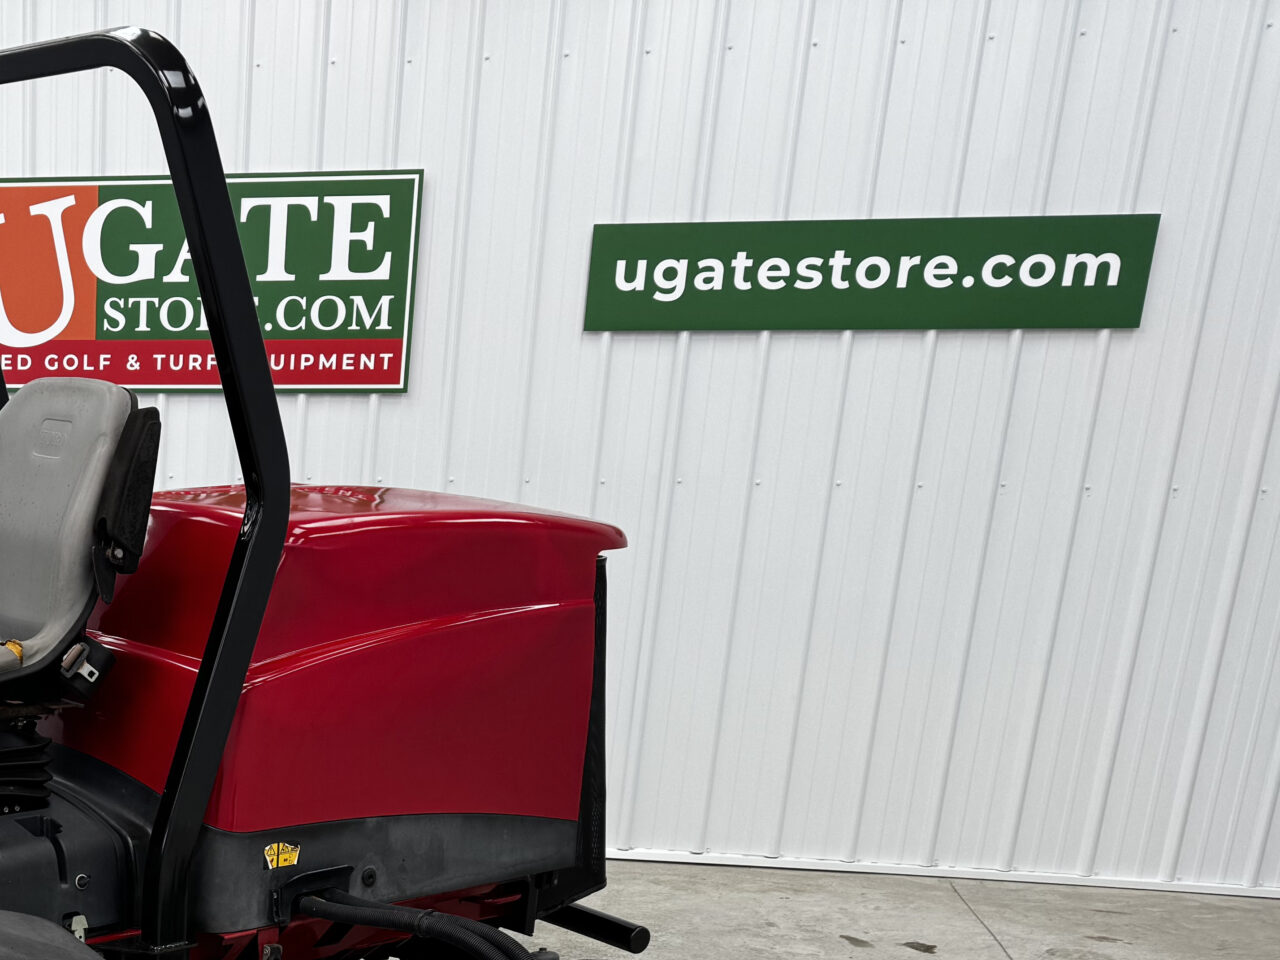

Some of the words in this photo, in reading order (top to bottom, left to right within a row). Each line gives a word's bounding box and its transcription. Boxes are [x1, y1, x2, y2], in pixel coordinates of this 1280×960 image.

[615, 249, 1122, 302] ugatestore.com
[103, 294, 396, 332] STO.COM
[44, 353, 112, 372] GOLF
[126, 354, 141, 371] &
[153, 353, 217, 371] TURF
[270, 352, 395, 371] UIPMENT
